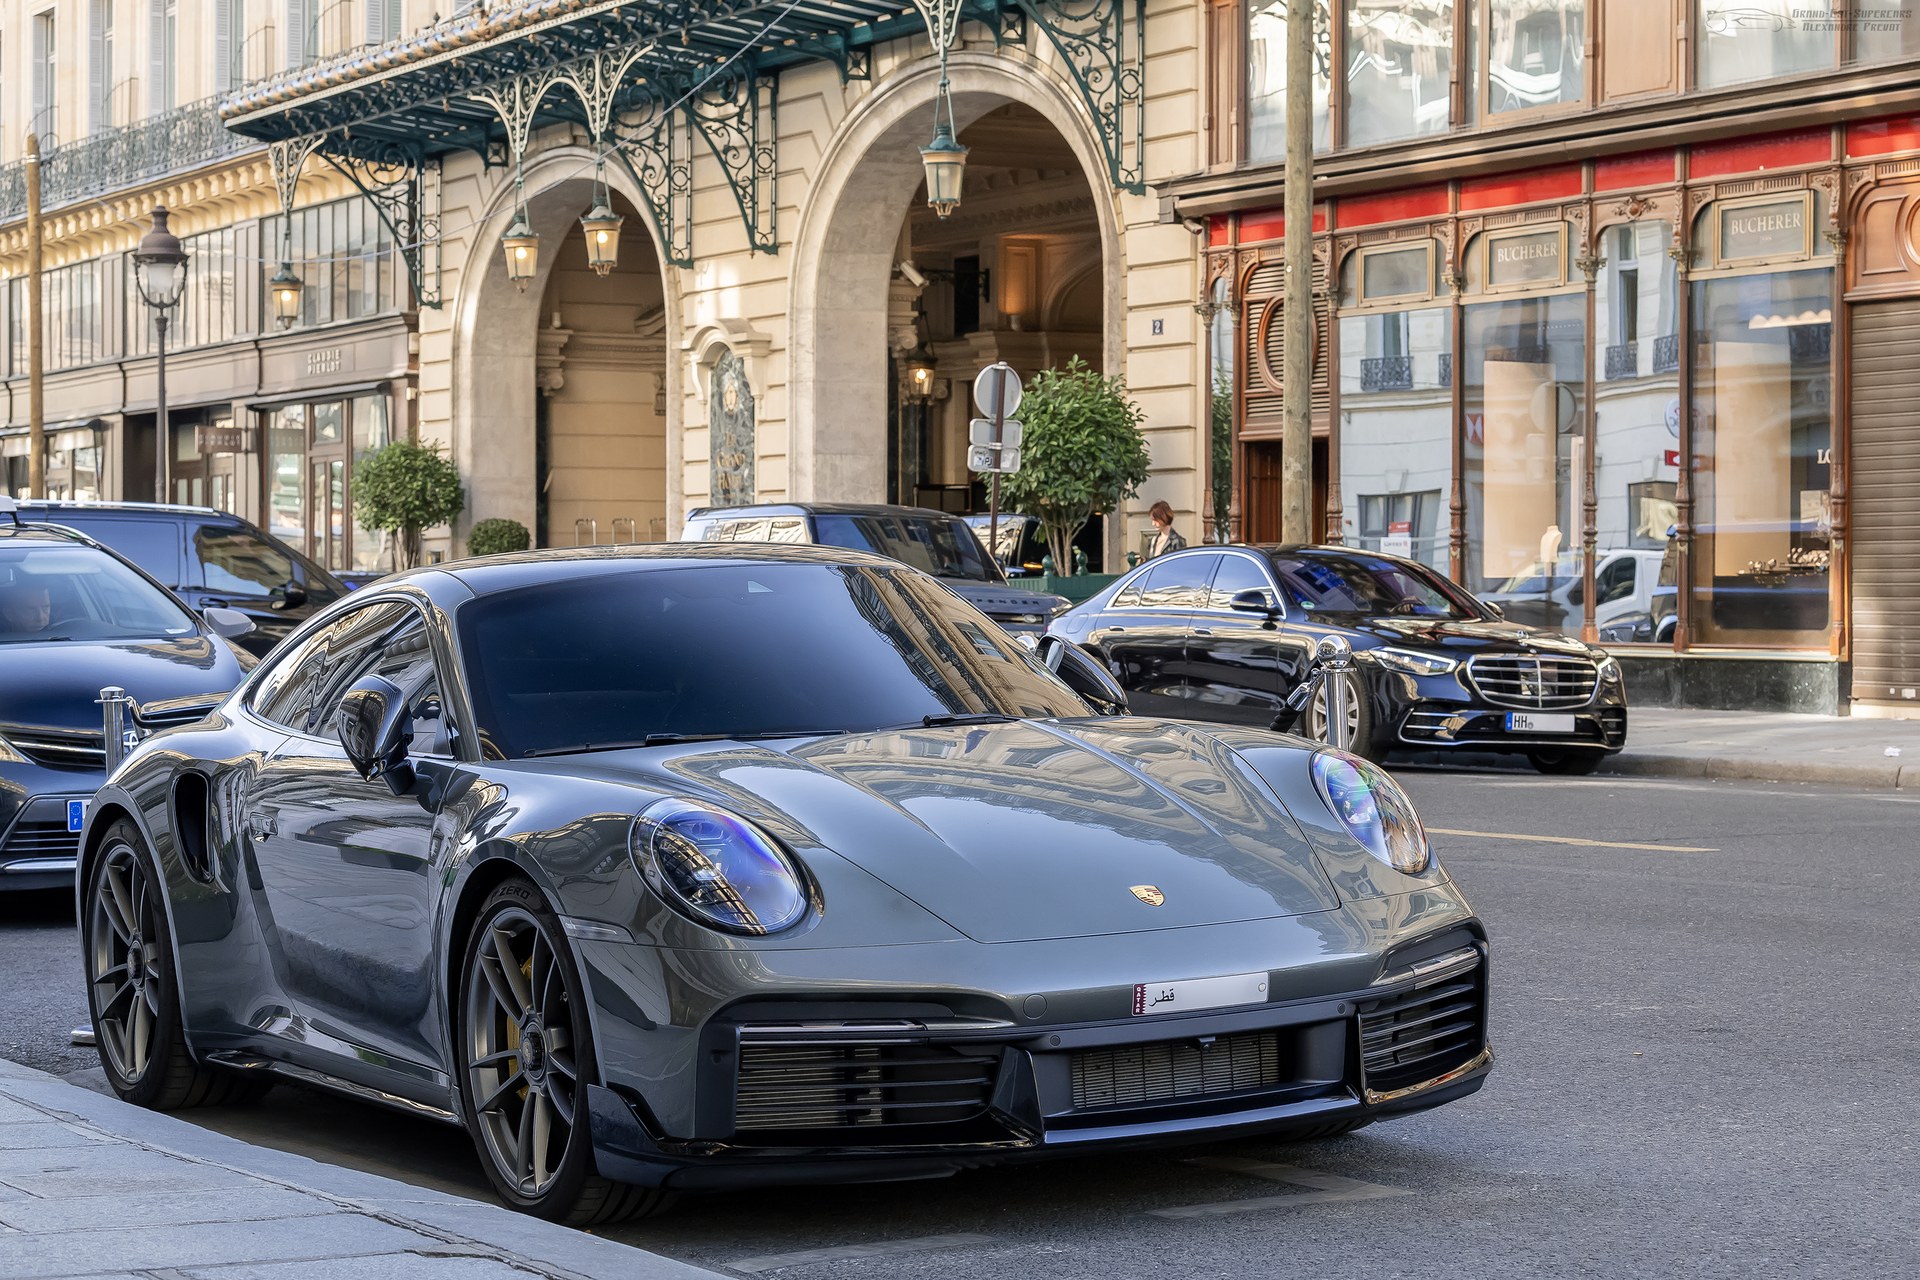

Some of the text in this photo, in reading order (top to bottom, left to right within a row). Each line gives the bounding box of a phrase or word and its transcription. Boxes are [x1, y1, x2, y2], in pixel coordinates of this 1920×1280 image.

[1730, 212, 1801, 235] BUCHERER
[1497, 241, 1558, 263] BUCHERER
[1513, 715, 1528, 729] HH
[499, 885, 531, 900] ZERO
[1148, 988, 1175, 1007] قطر
